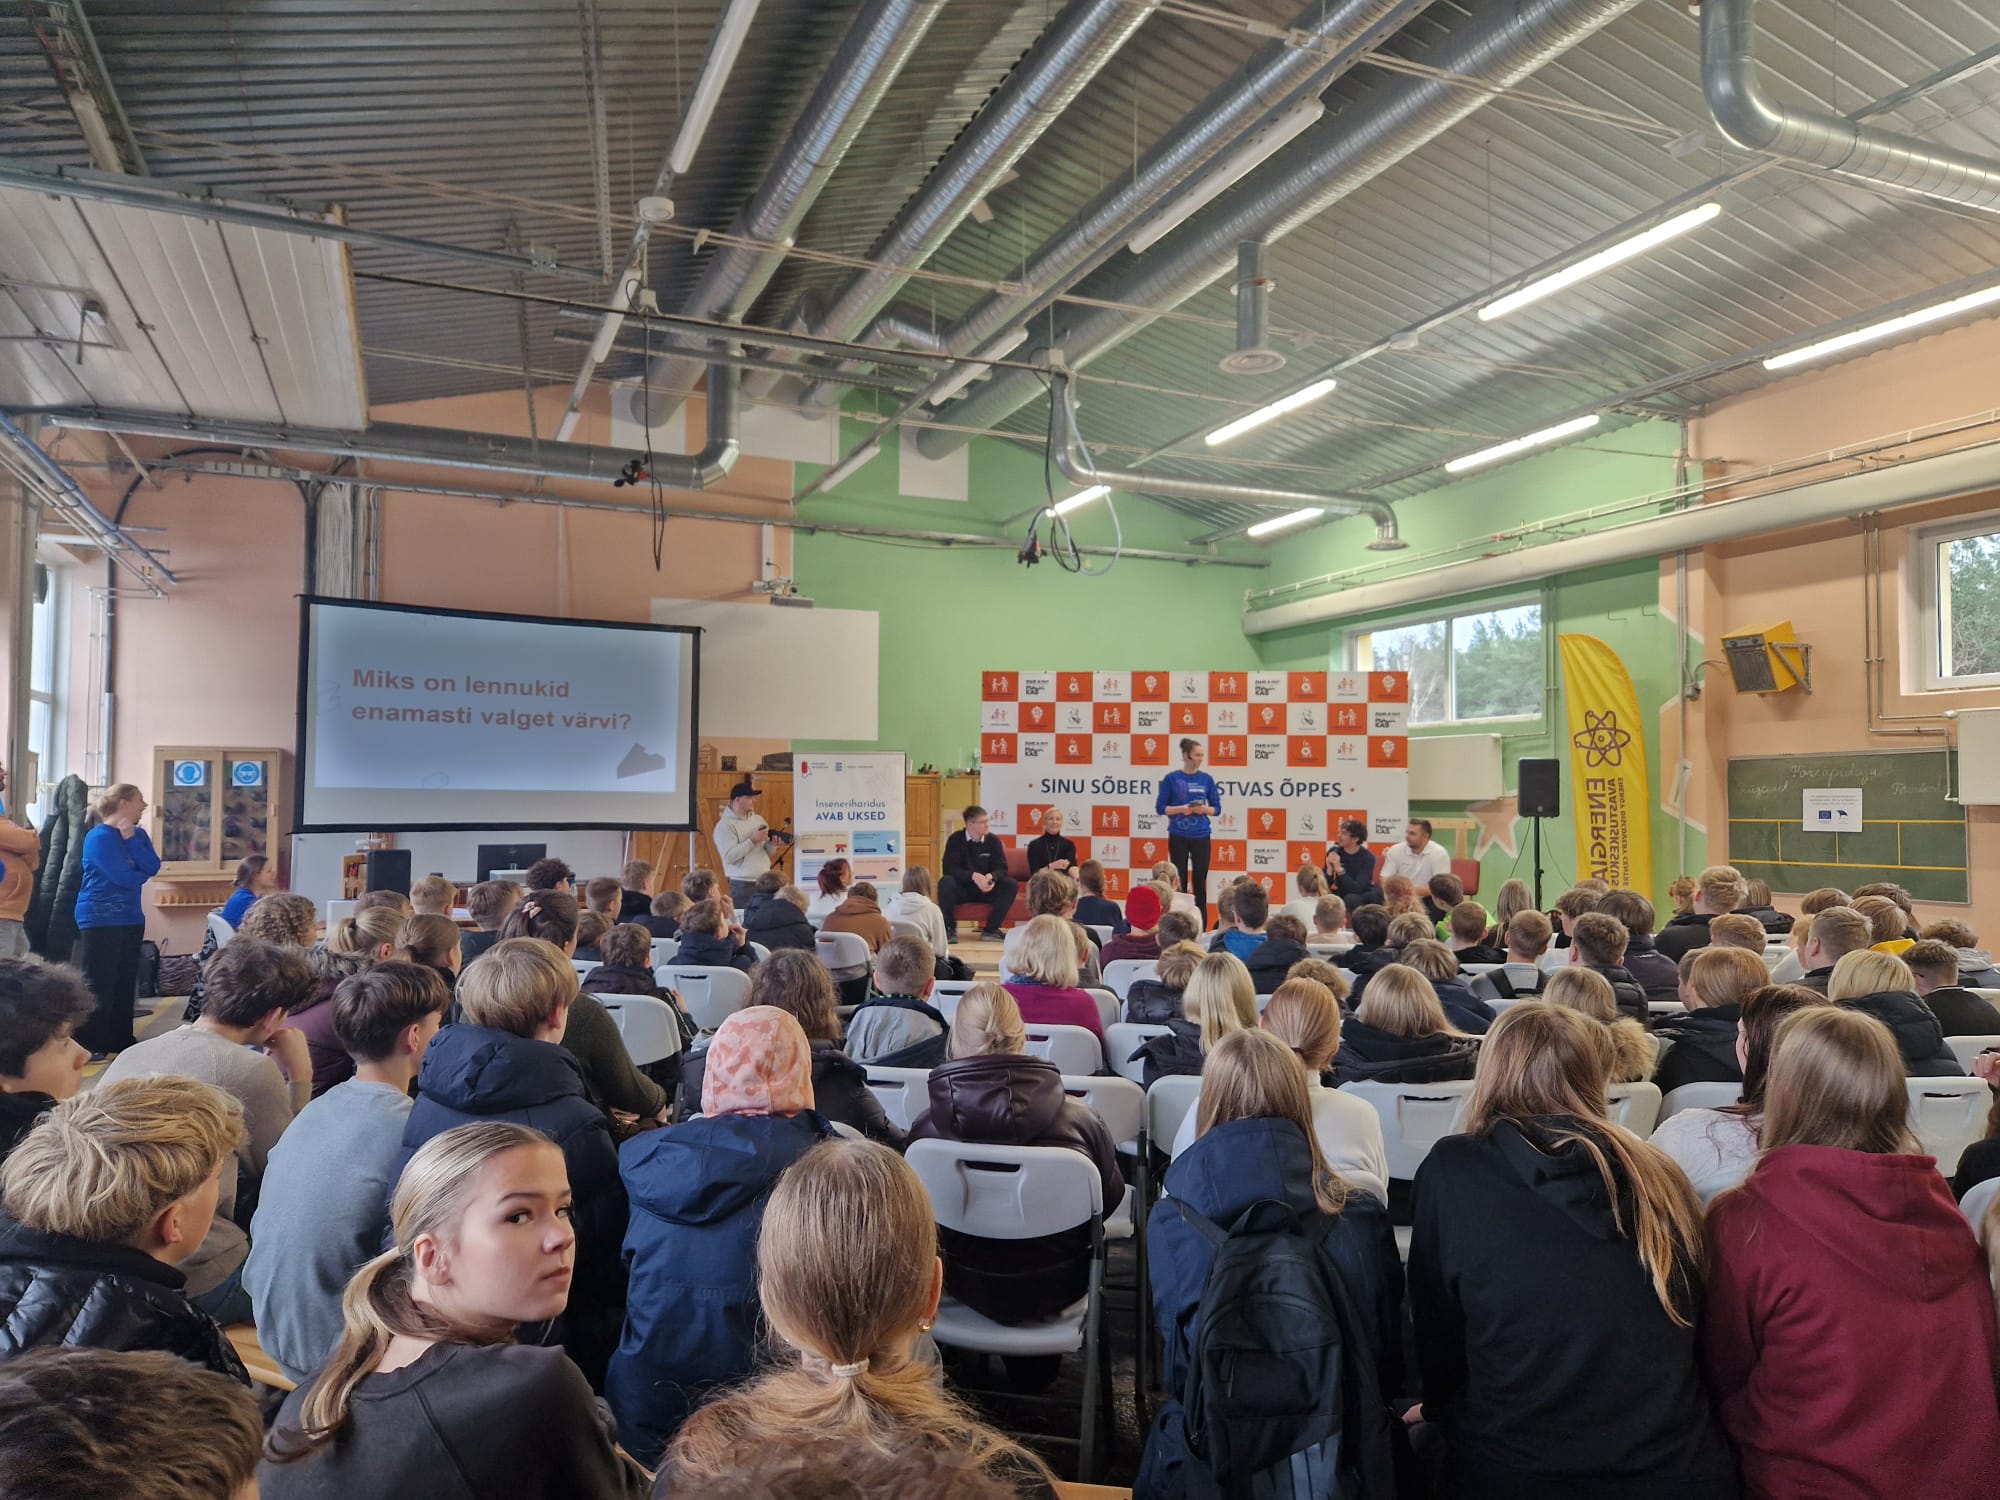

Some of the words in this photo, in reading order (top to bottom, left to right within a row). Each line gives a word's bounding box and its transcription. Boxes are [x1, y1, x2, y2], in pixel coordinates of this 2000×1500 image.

[352, 668, 414, 691] Miks
[424, 675, 456, 693] on
[465, 675, 570, 699] lennukid
[351, 704, 472, 725] enamasti
[481, 708, 555, 731] valget
[561, 712, 632, 731] värvi?
[1041, 778, 1085, 794] SINU
[1091, 776, 1151, 795] SÕBER
[1280, 778, 1342, 798] ÕPPES
[815, 799, 886, 808] Inseneriharidus
[815, 811, 844, 821] AVAB
[847, 811, 886, 821] UKSED
